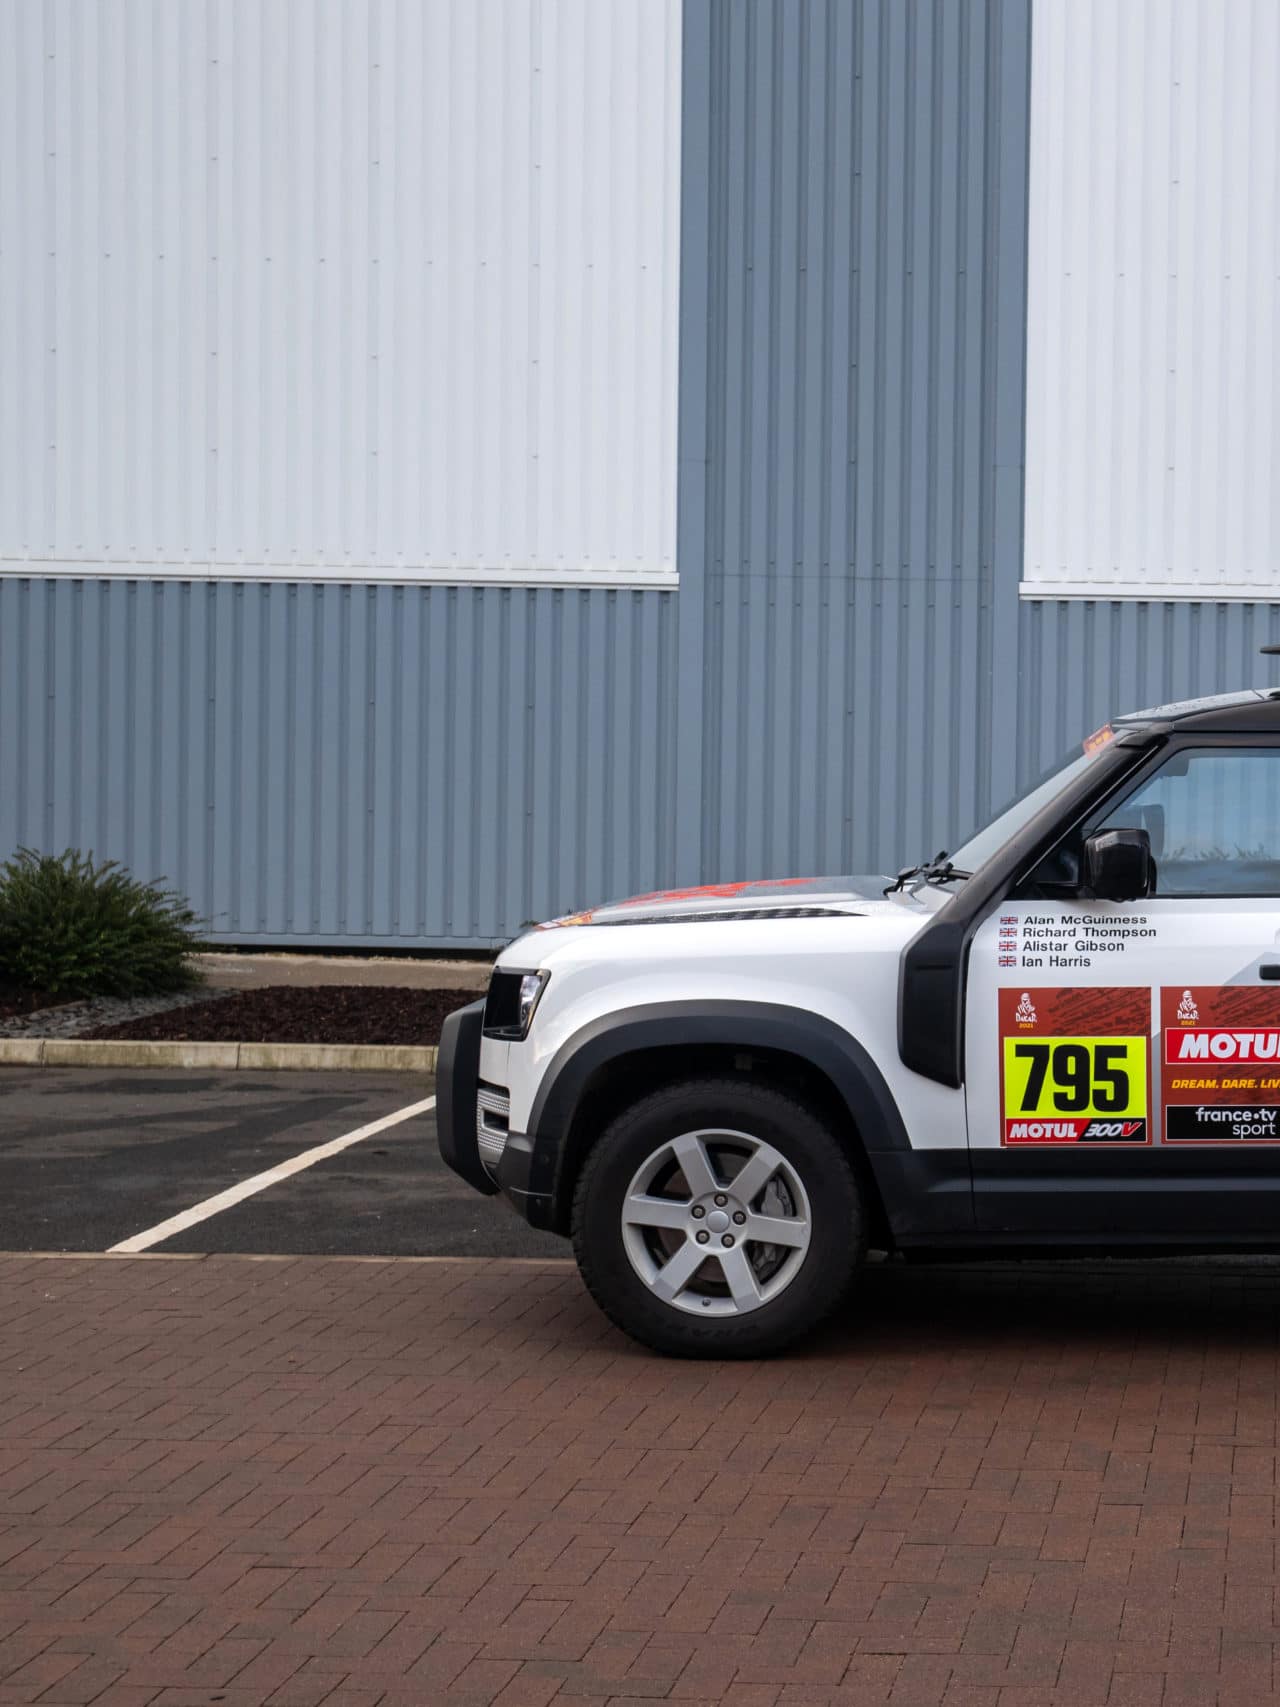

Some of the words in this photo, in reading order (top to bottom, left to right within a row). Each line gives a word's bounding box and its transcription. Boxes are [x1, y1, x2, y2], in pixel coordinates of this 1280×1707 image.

[1024, 916, 1055, 925] Alan
[1060, 915, 1147, 925] McGuinness
[1022, 927, 1076, 938] Richard
[1083, 927, 1157, 939] Thompson
[1022, 940, 1068, 952] Alistar
[1074, 940, 1125, 952] Gibson
[1021, 956, 1043, 967] Ian
[1049, 956, 1091, 967] Harris
[1015, 1044, 1130, 1113] 795
[1171, 1079, 1219, 1089] DREAM.
[1221, 1079, 1258, 1089] DARE.
[1009, 1123, 1078, 1138] MOTUL
[1084, 1121, 1143, 1138] 300V
[1232, 1122, 1276, 1139] sport
